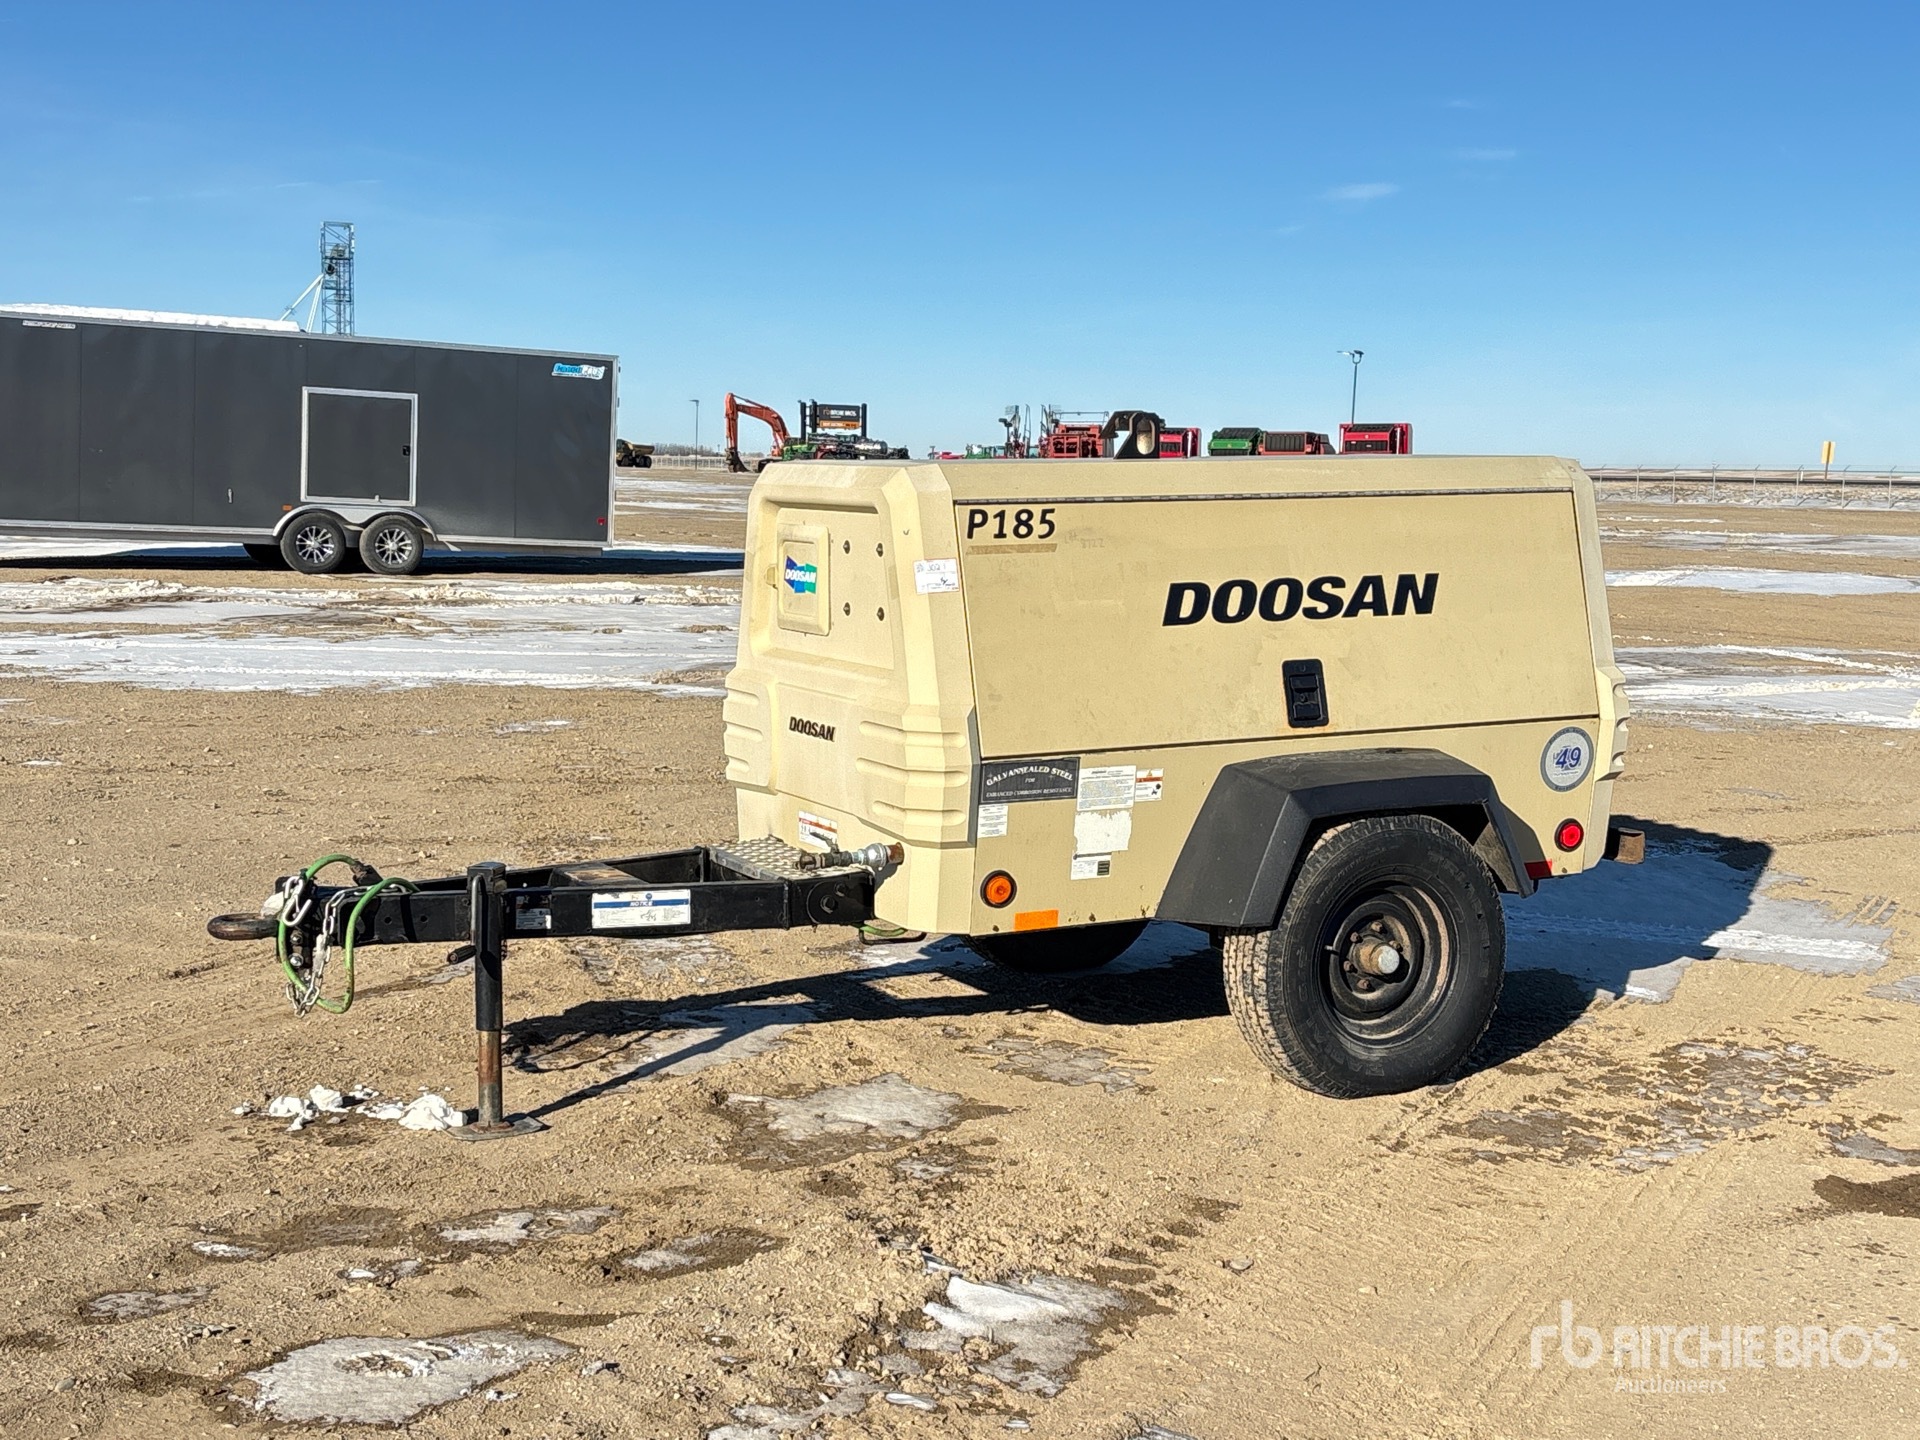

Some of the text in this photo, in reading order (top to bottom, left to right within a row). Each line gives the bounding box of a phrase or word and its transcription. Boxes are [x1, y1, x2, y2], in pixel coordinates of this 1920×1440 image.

[967, 508, 1055, 539] P185
[785, 569, 816, 583] DOOSAN
[1162, 573, 1439, 626] DOOSAN
[789, 716, 835, 742] DOOSAN
[1555, 747, 1582, 769] 49
[1051, 767, 1073, 781] STEEL
